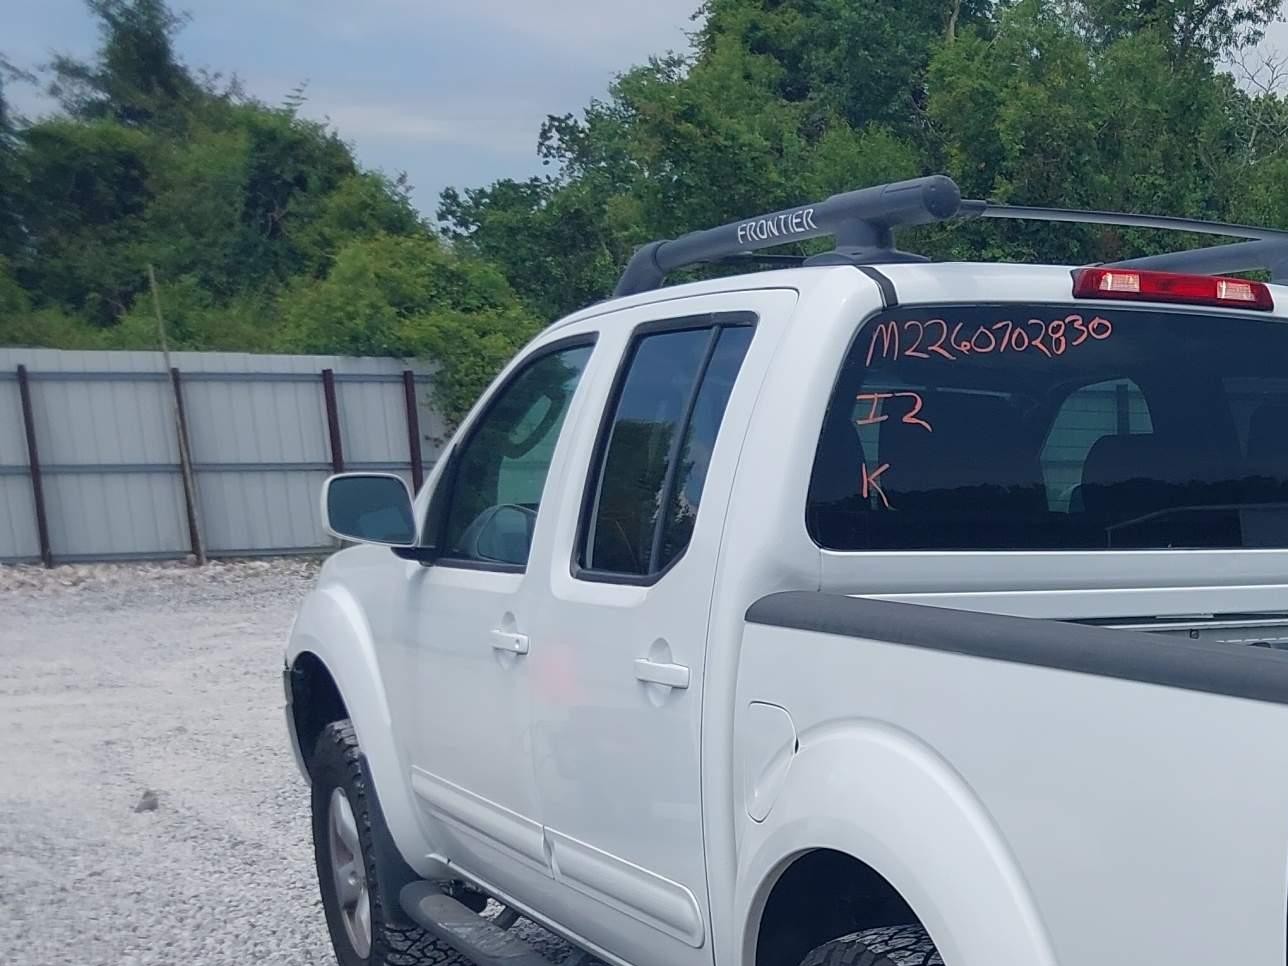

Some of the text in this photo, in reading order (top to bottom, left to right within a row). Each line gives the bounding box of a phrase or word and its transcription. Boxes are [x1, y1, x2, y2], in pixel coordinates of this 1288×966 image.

[737, 208, 818, 244] FRONTIER
[865, 314, 1112, 367] M2260702830
[861, 463, 891, 508] K
